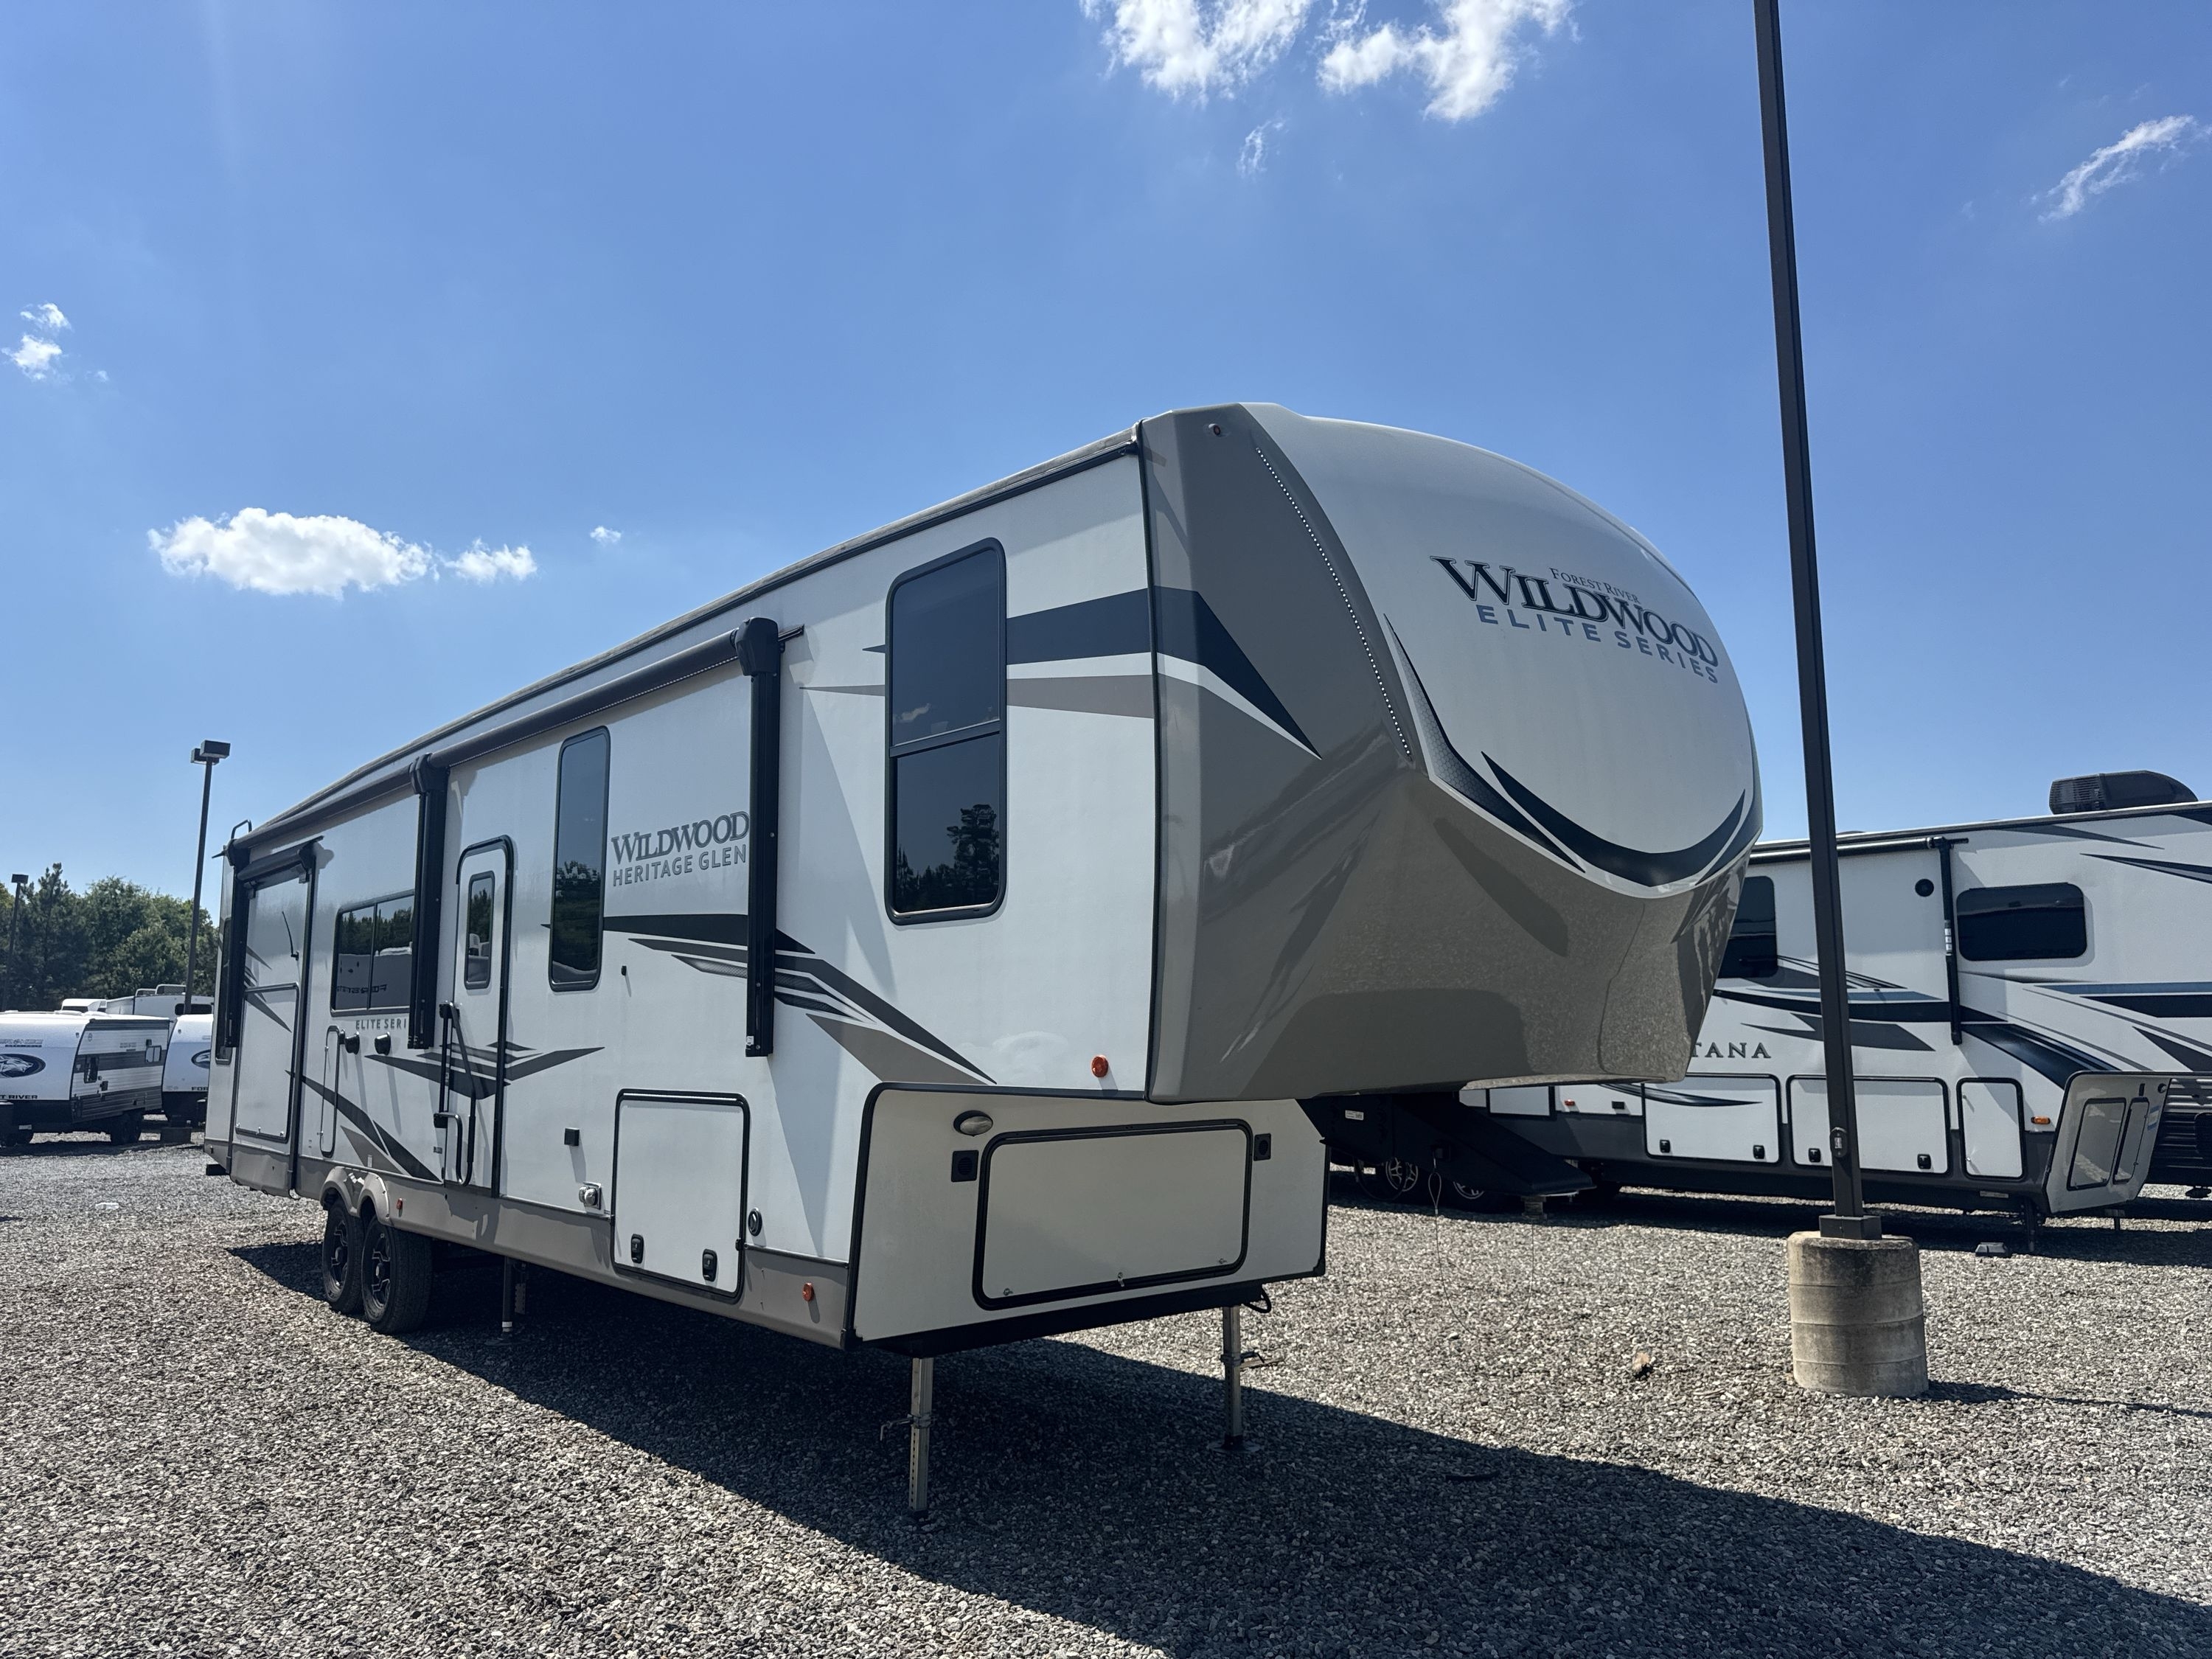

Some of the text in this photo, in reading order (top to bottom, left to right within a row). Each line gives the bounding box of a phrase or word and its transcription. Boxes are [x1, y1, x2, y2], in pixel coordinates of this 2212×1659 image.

[1549, 567, 1641, 605] FOREST RIVER
[1430, 555, 1719, 667] WILDWOOD
[1476, 604, 1718, 684] ELITE SERIES
[611, 811, 749, 865] WILDWOOD
[613, 844, 746, 887] HERITAGE GLEN
[355, 1019, 381, 1030] ELITE
